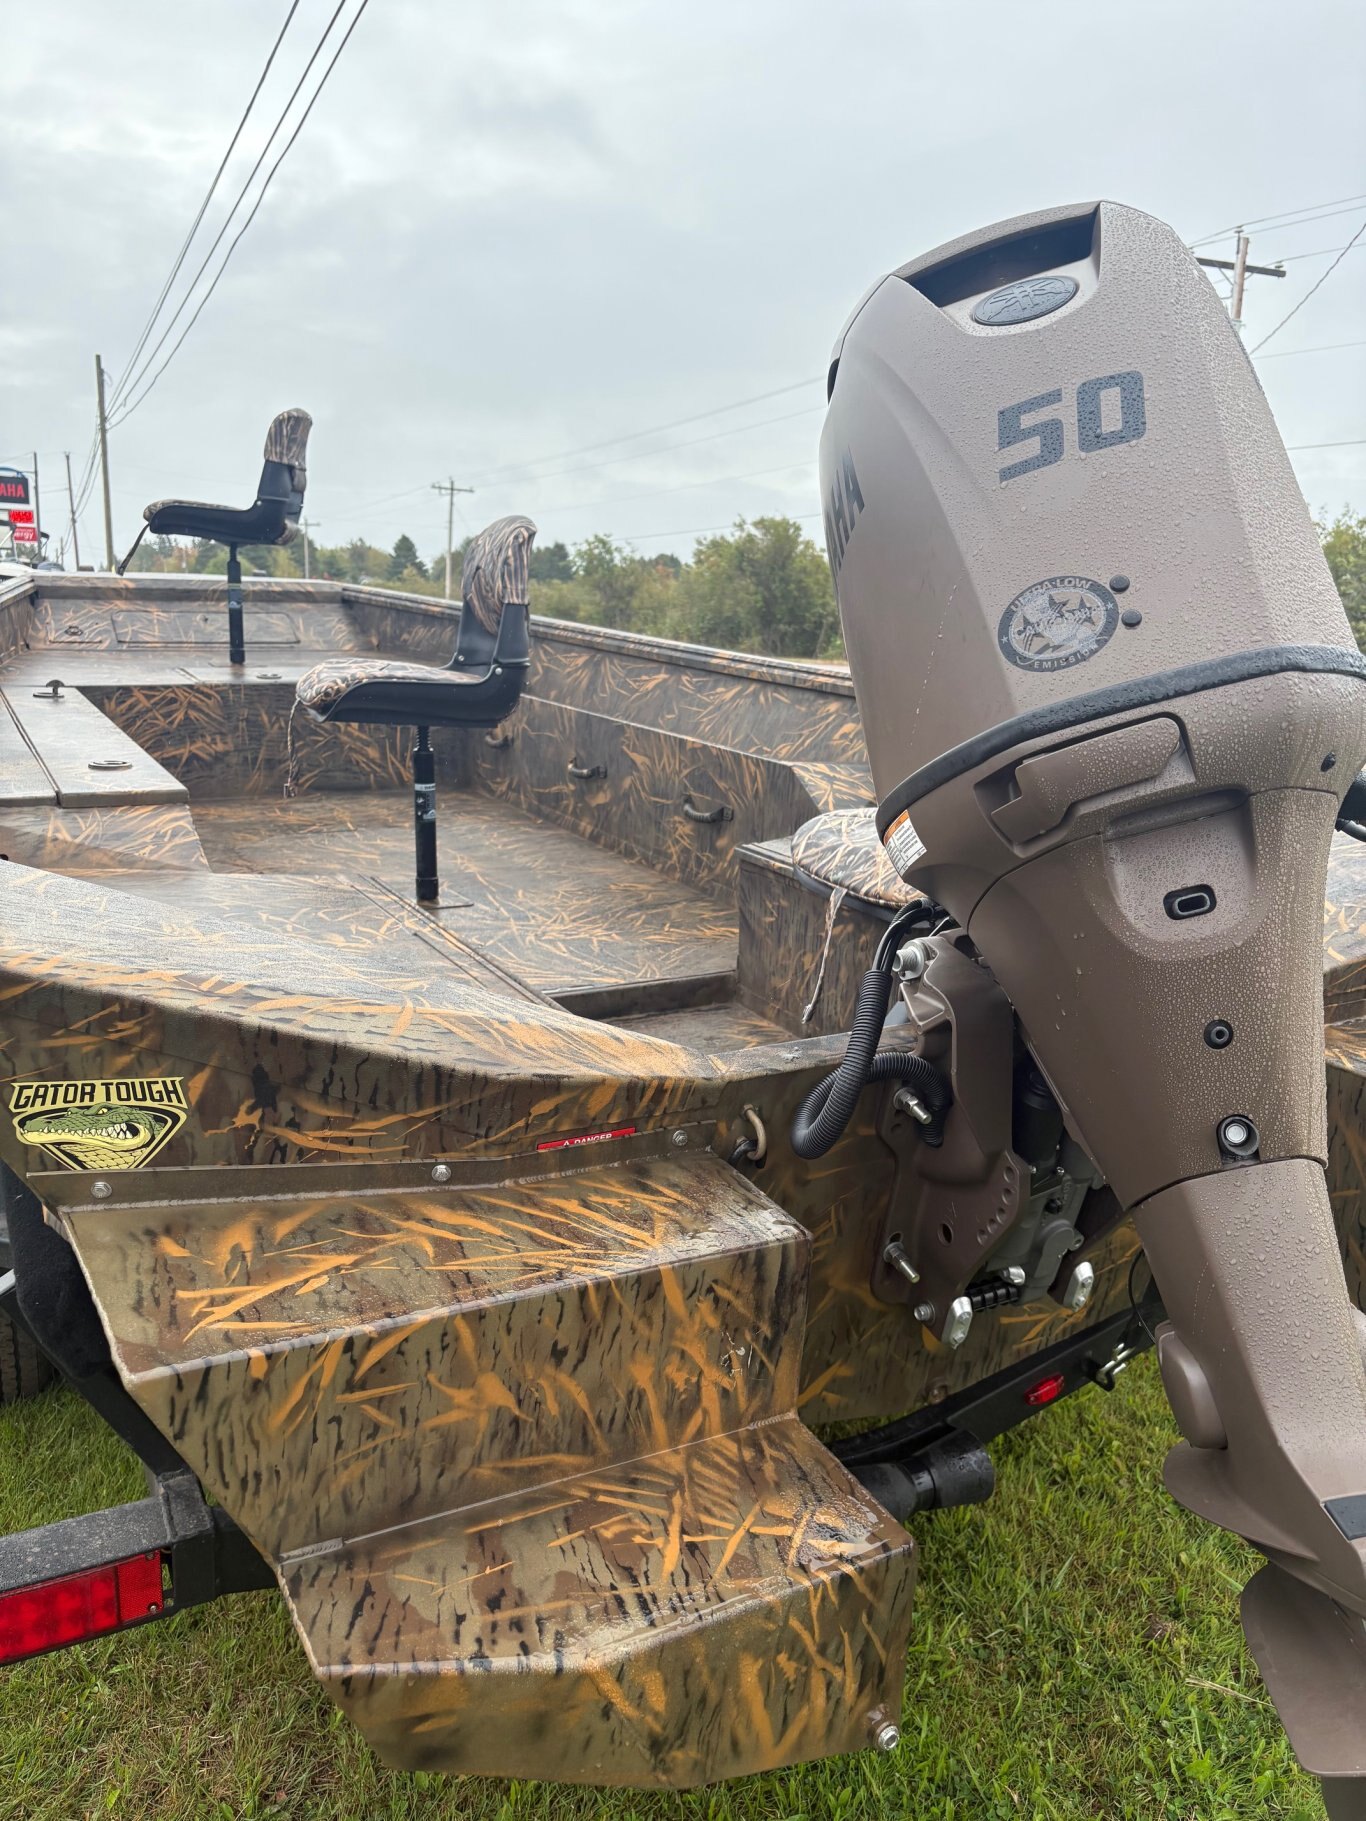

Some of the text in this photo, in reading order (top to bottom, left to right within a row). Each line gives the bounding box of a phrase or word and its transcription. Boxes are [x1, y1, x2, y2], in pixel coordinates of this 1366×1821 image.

[998, 370, 1147, 483] 50
[14, 1079, 183, 1110] GATOR TOUGH
